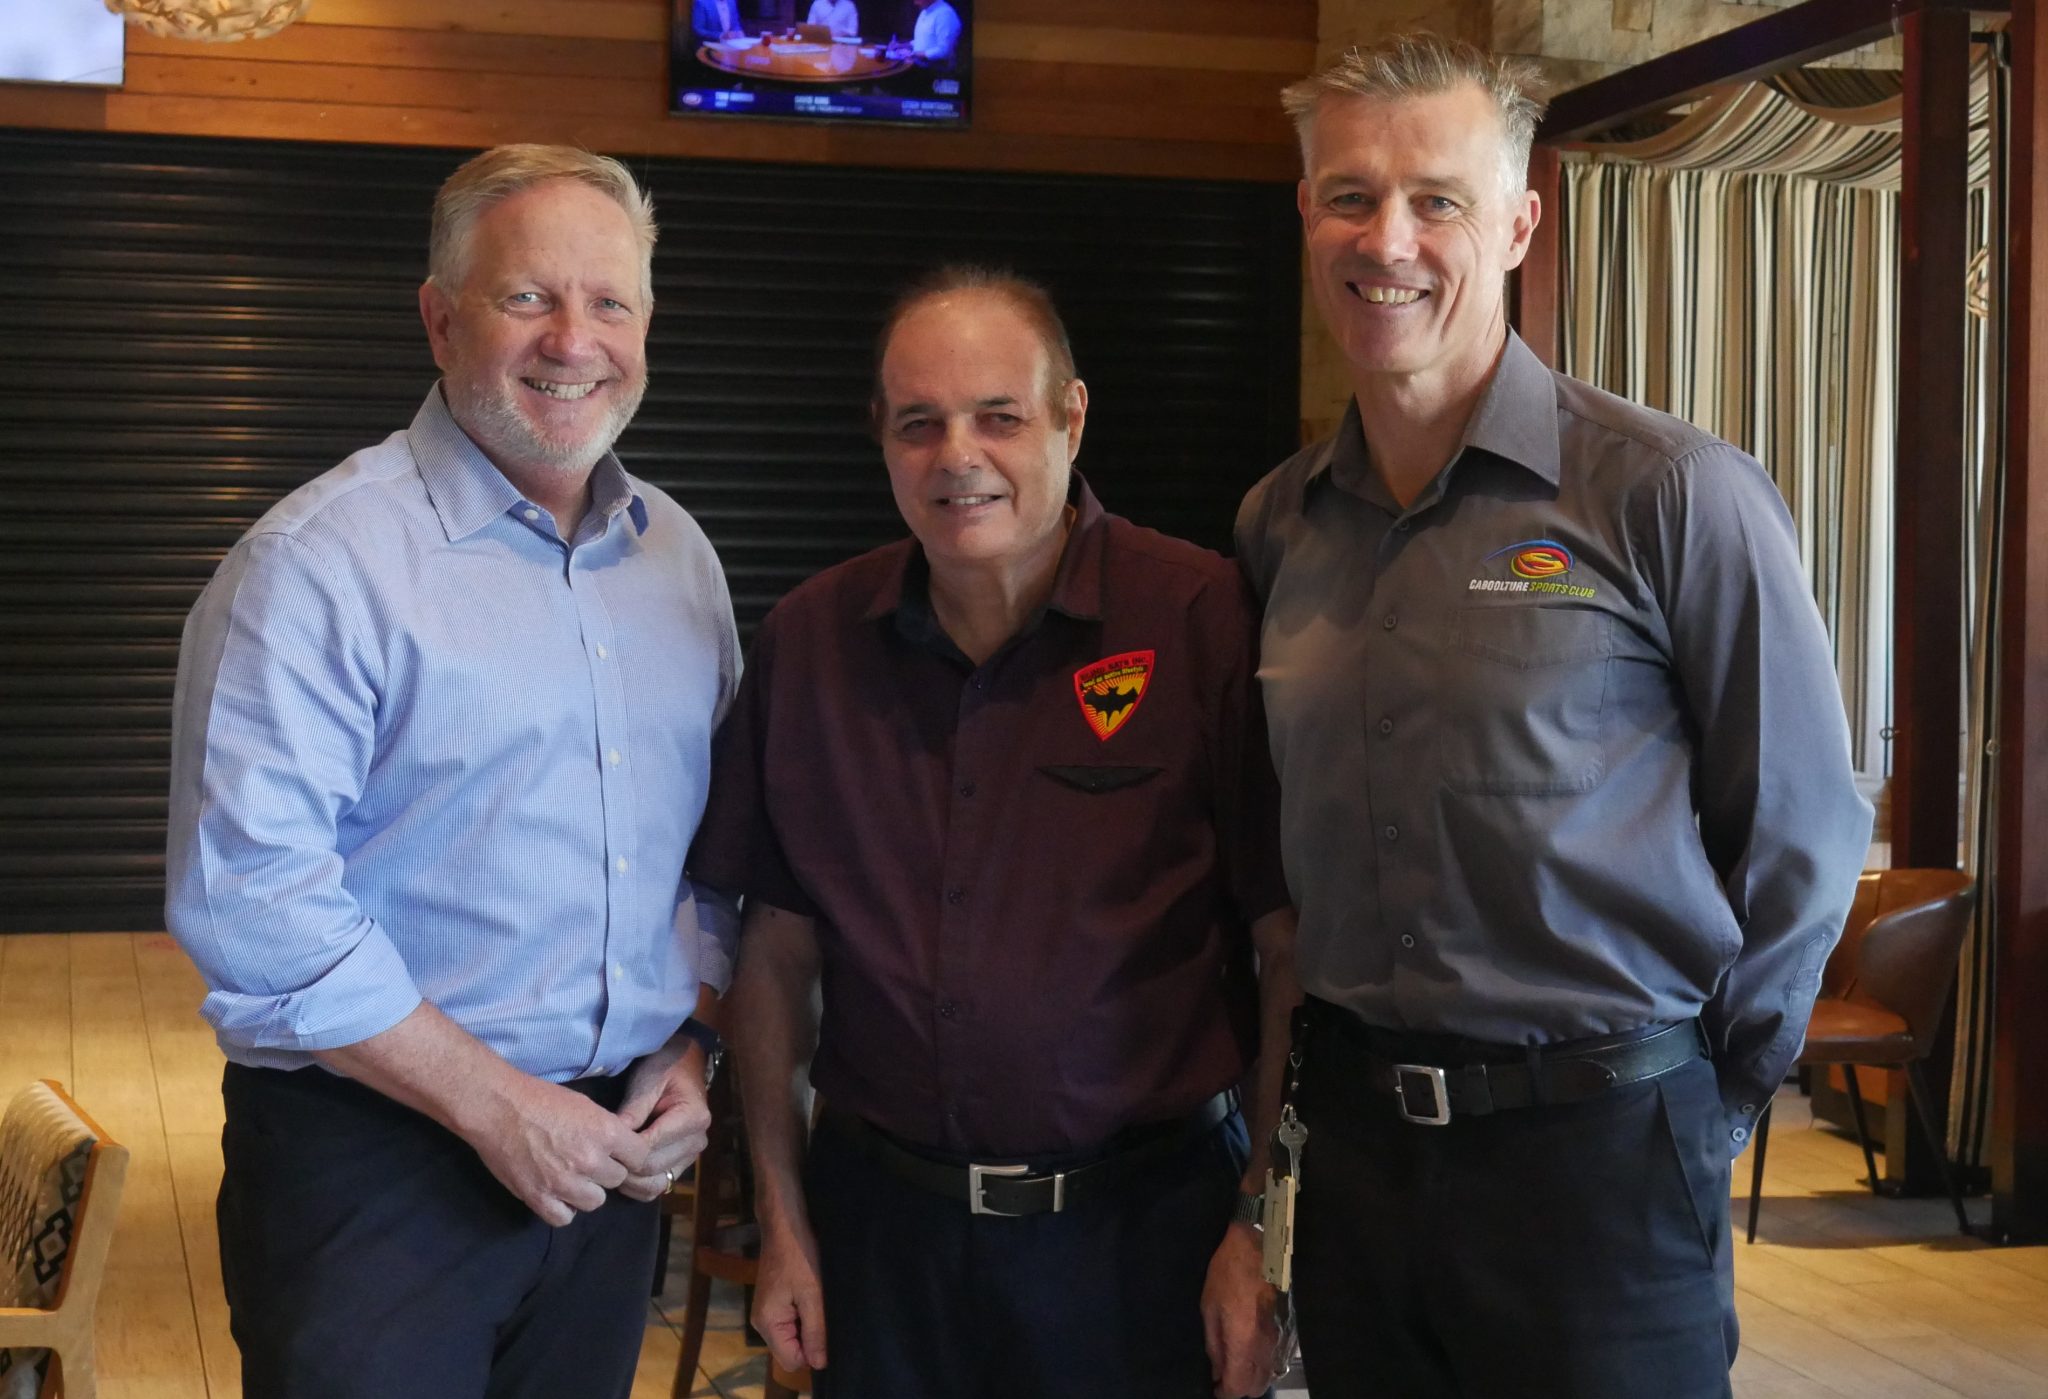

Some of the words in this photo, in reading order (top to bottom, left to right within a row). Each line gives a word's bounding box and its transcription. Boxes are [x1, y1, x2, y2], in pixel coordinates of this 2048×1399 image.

[1469, 579, 1530, 592] CABOOLTURE
[1529, 582, 1568, 594] SPORTS
[1568, 585, 1595, 598] CLUB
